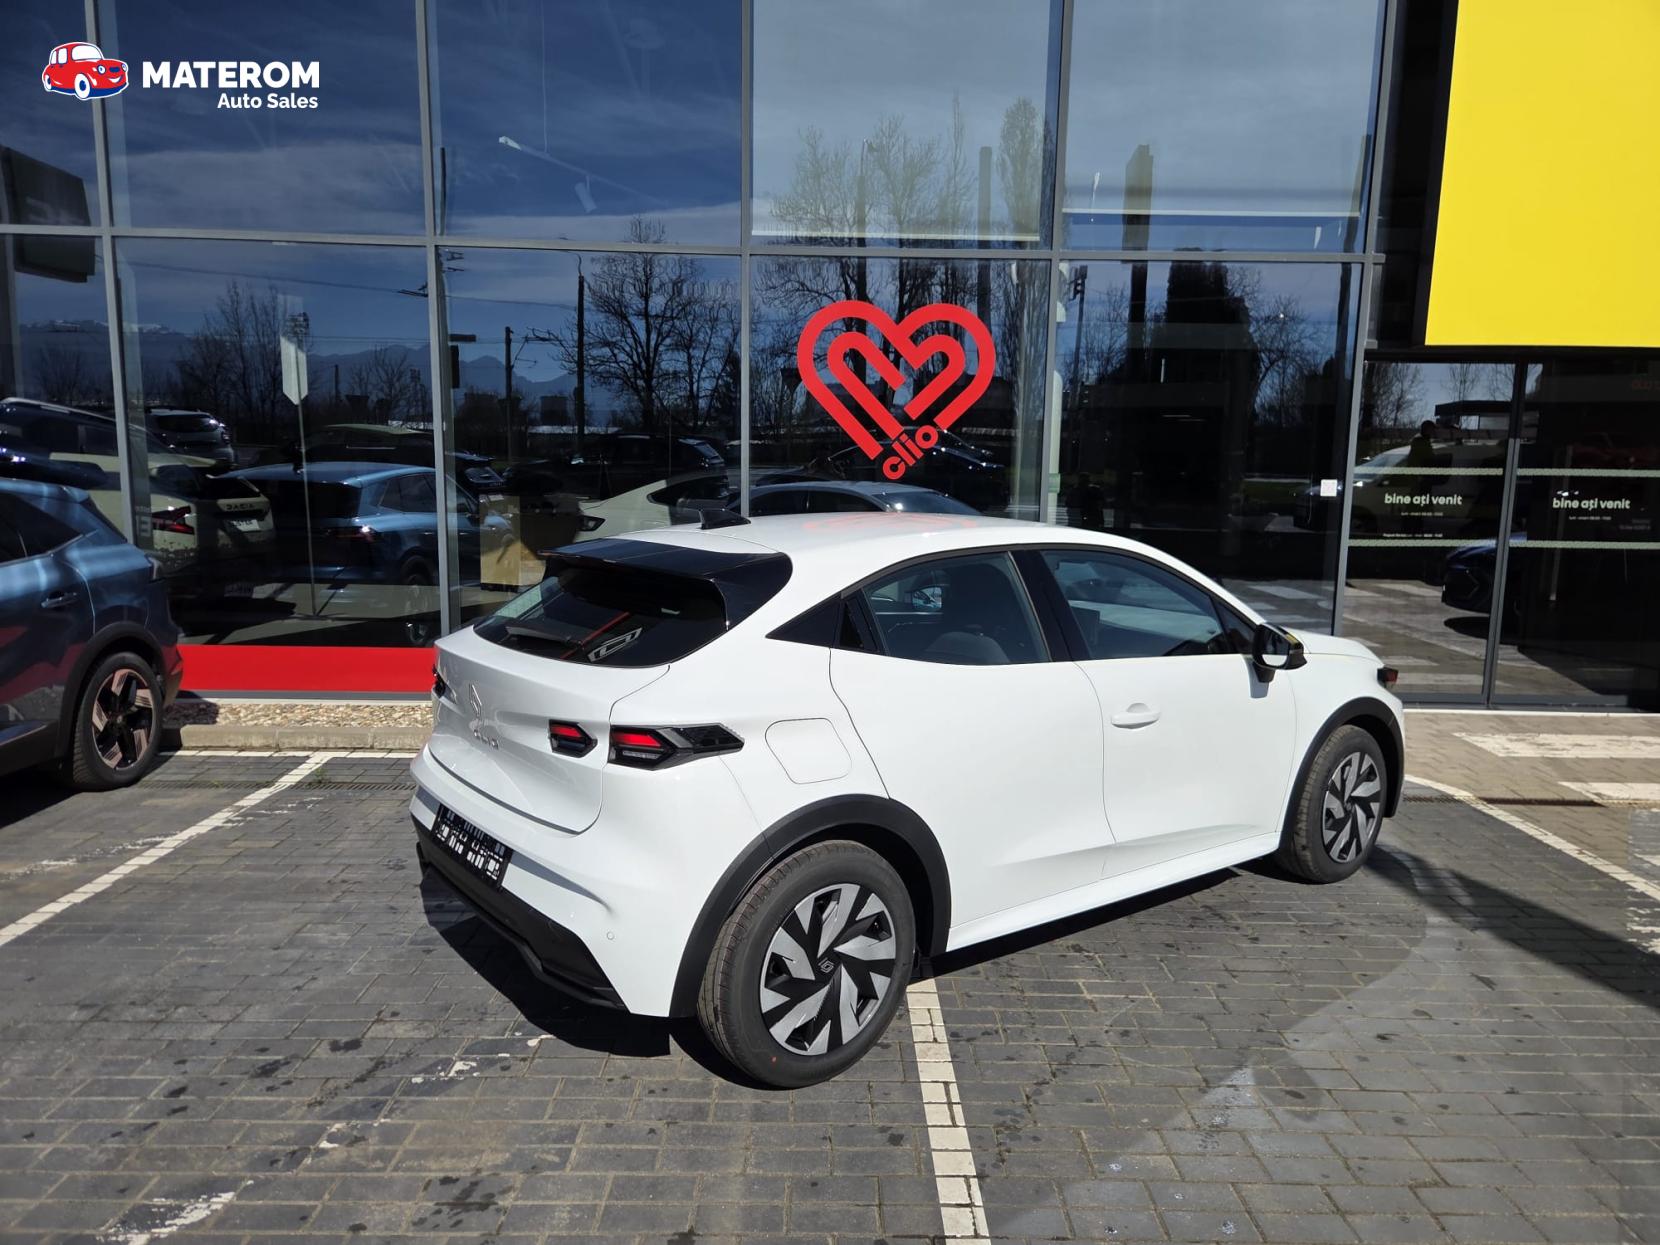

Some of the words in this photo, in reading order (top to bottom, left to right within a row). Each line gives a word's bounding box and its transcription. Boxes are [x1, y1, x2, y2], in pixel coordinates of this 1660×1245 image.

[882, 425, 939, 480] clio
[1384, 492, 1411, 504] bine
[1431, 494, 1462, 505] venit
[1552, 497, 1579, 509] bine
[1600, 498, 1631, 509] venit
